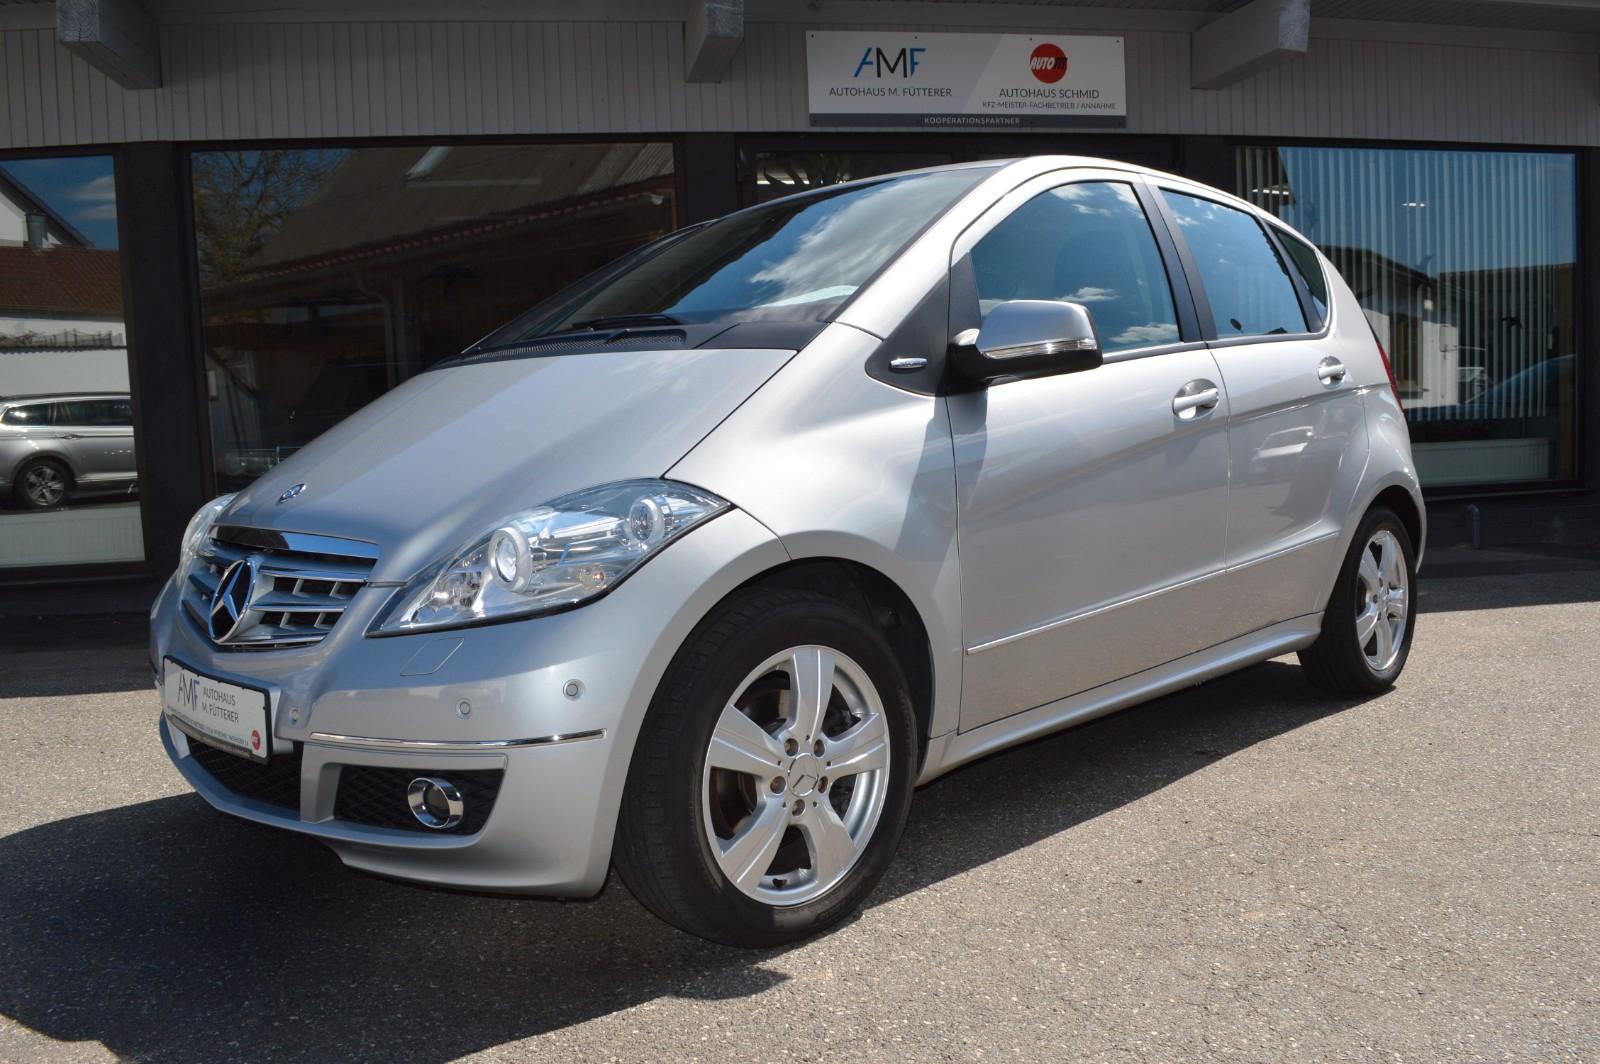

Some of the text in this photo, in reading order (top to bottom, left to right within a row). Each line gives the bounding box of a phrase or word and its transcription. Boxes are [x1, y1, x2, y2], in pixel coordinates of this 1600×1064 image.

[853, 47, 926, 78] AMF
[829, 86, 952, 97] AUTOHAUS M. FÜTTERER
[999, 88, 1100, 99] AUTOHAUS SCHMID
[982, 101, 1076, 110] KFZ-MEISTER-FACHBETRIEB
[1081, 102, 1116, 110] ANNAHME
[924, 117, 1020, 125] KOOPERATIONSPARTNER
[178, 672, 200, 713] AMF
[203, 687, 236, 706] AUTOHAUS
[202, 702, 209, 714] M.
